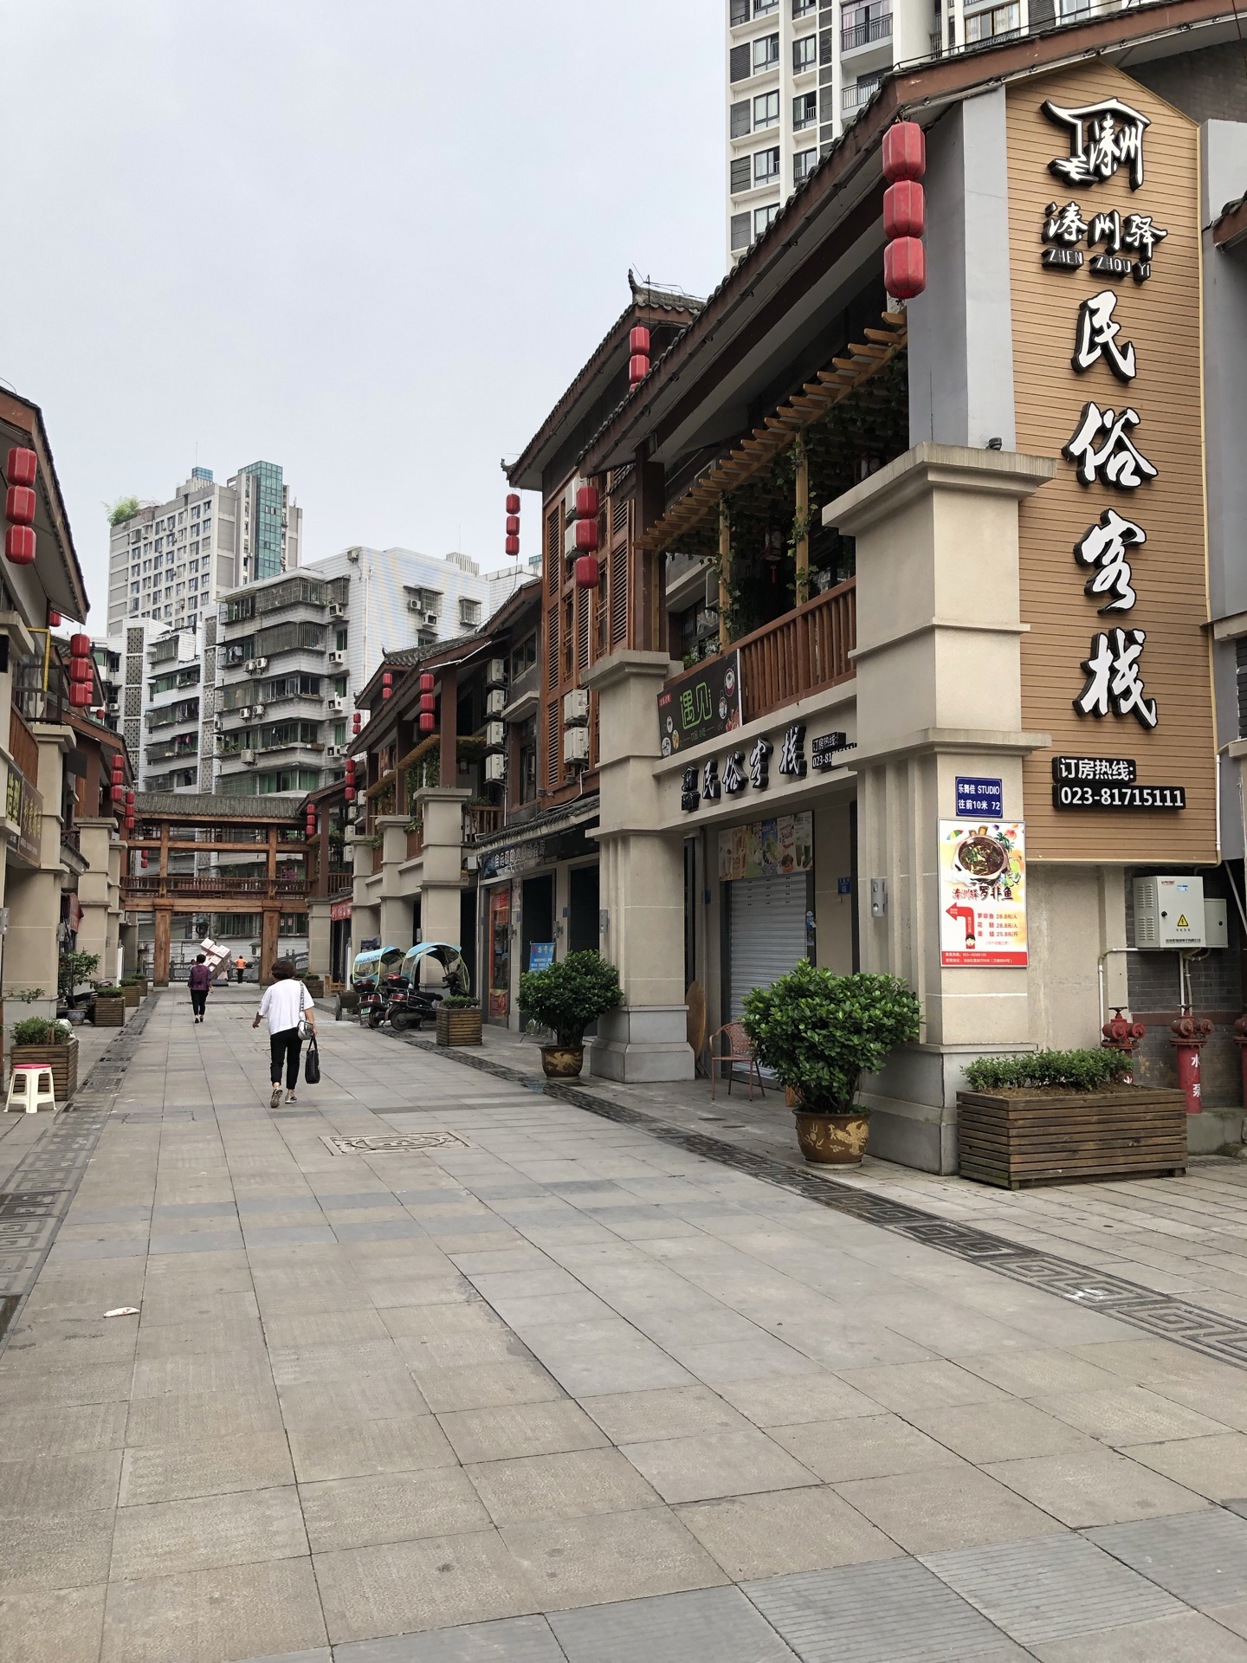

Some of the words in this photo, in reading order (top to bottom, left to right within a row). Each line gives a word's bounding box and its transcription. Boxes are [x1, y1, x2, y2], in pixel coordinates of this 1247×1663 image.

[1046, 248, 1084, 267] ZHEN
[1093, 254, 1132, 275] ZHOU
[1136, 263, 1151, 280] YI
[1064, 290, 1158, 729] 民俗客栈
[680, 682, 712, 729] 遇见
[702, 725, 806, 799] 民俗客栈
[1059, 758, 1135, 782] 订房热线:
[977, 785, 1000, 795] STUDIO
[1060, 785, 1184, 808] 023-81715111
[958, 799, 988, 810] 往前10米
[991, 801, 1001, 810] 72
